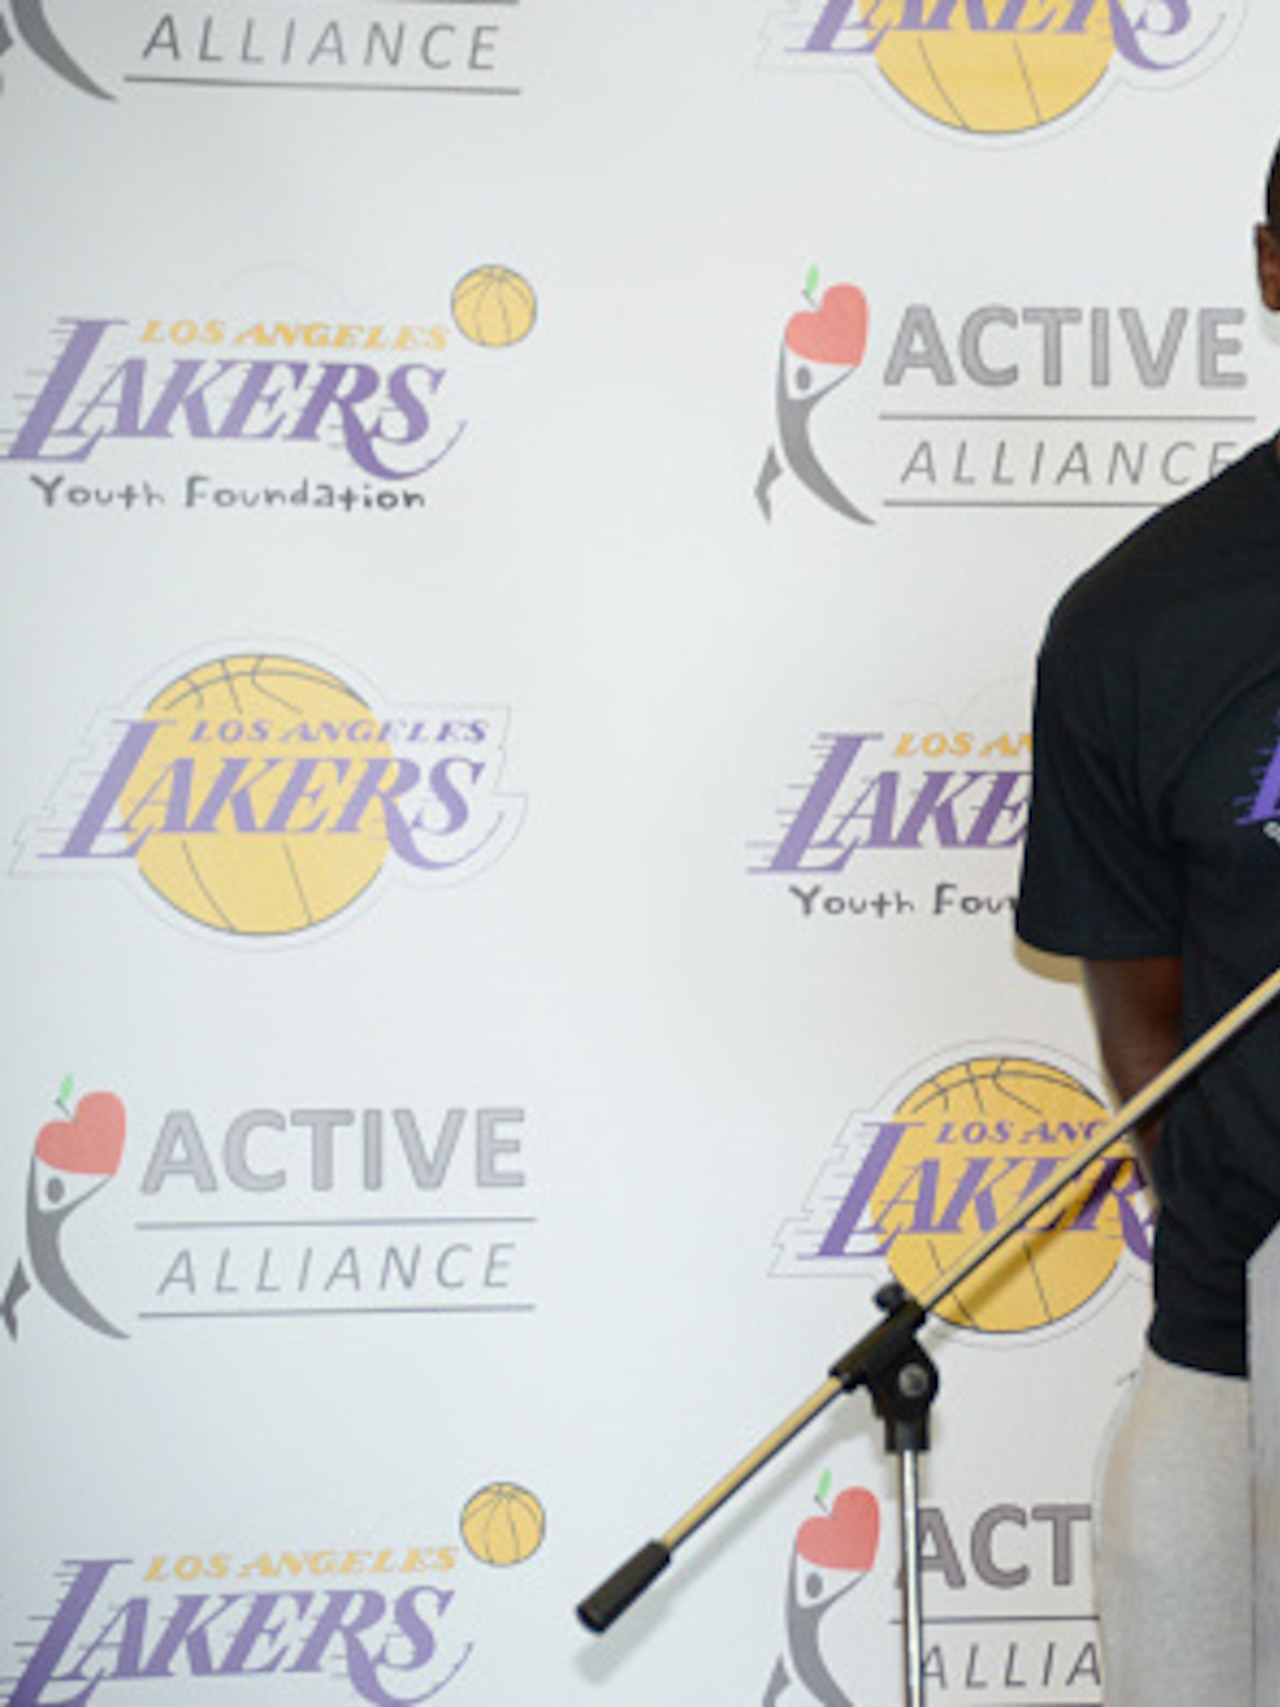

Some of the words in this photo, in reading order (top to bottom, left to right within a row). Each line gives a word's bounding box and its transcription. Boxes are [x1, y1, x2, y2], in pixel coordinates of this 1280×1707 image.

[141, 13, 502, 71] ALLIANCE
[140, 319, 226, 346] LOS
[234, 322, 453, 351] ANGELES
[882, 303, 1248, 388] ACTIVE
[0, 317, 468, 481] LAKERS
[29, 474, 166, 510] Youth
[184, 475, 427, 512] Foundation
[190, 718, 273, 743] LOS
[279, 718, 490, 744] ANGELES
[892, 731, 975, 759] LOS
[37, 718, 505, 871] LAKERS
[788, 885, 915, 919] Youth
[139, 1107, 528, 1196] ACTIVE
[935, 1120, 1014, 1145] LOS
[156, 1242, 518, 1296] ALLIANCE
[142, 1554, 229, 1583] LOS
[236, 1545, 460, 1580] ANGELES
[4, 1556, 474, 1707] LAKERS
